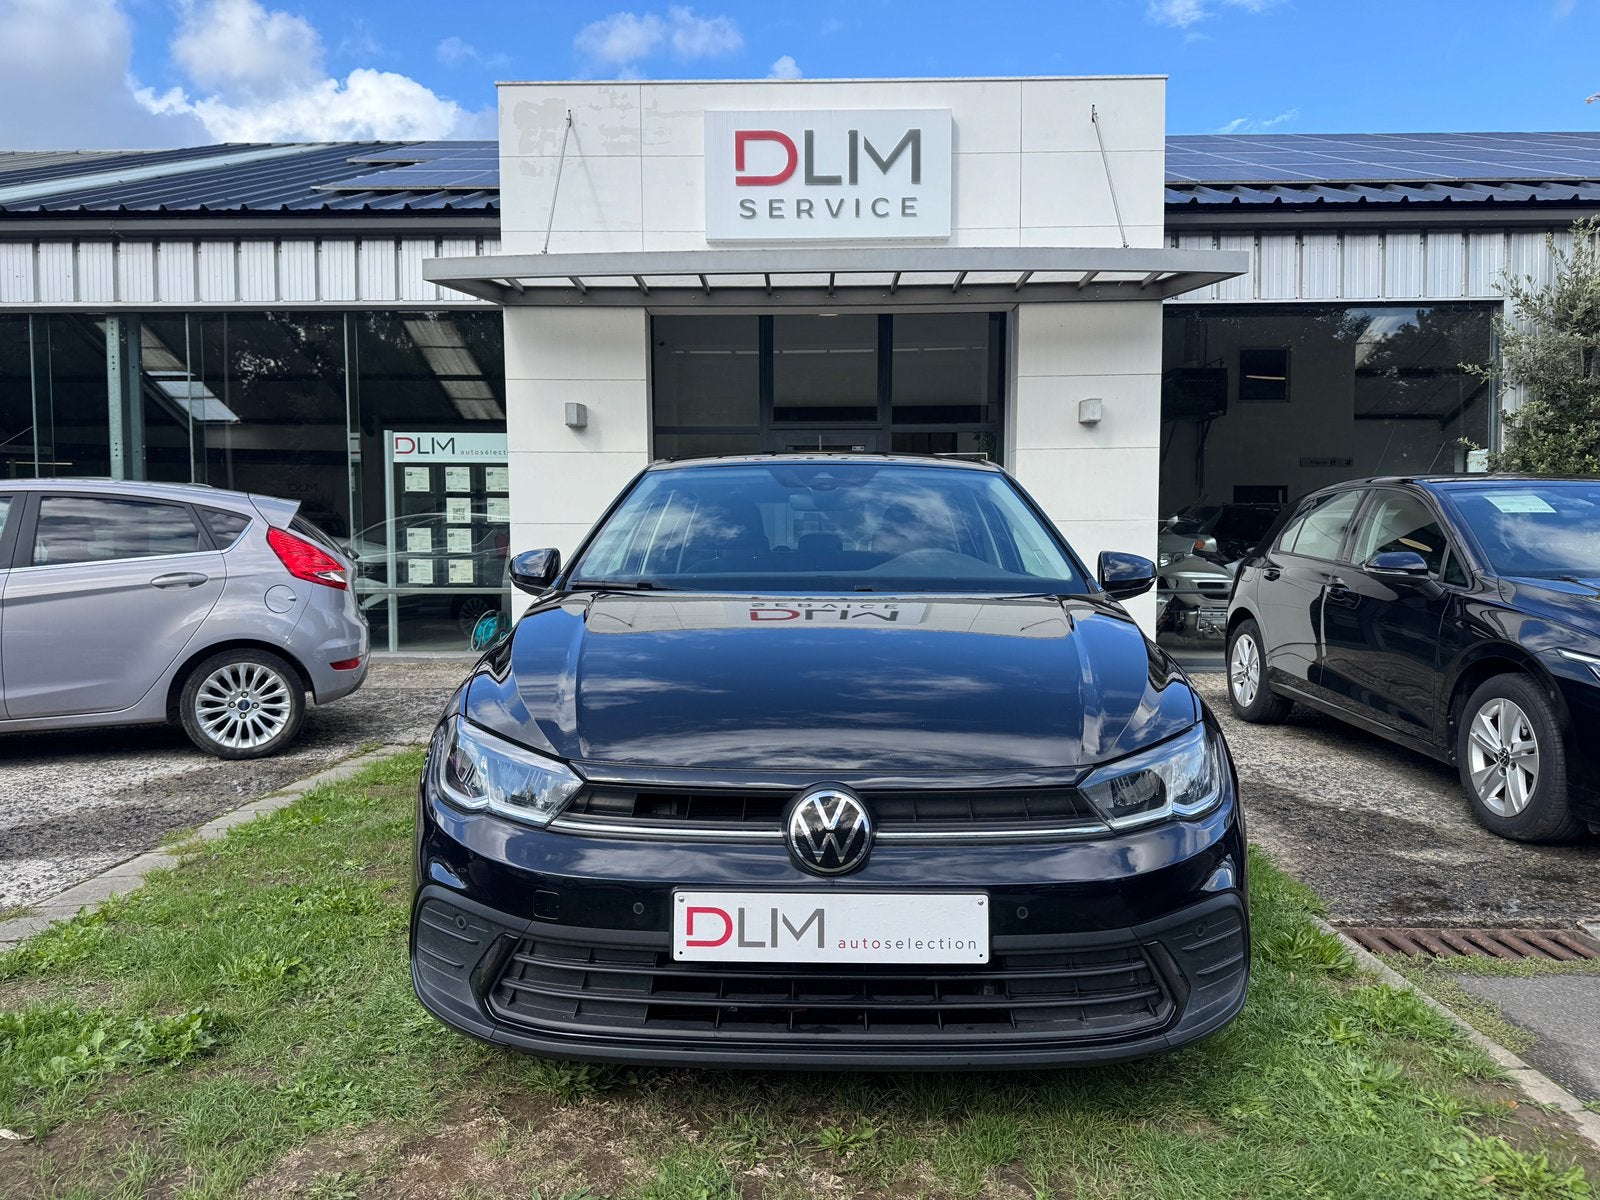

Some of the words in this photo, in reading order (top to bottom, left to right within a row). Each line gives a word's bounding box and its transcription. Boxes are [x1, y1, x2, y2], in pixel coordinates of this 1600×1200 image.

[735, 129, 921, 186] DLM
[739, 197, 918, 219] SERVICE
[395, 437, 455, 454] DLM
[793, 793, 867, 868] VW
[686, 906, 825, 948] DLM
[838, 937, 977, 950] autoselection
